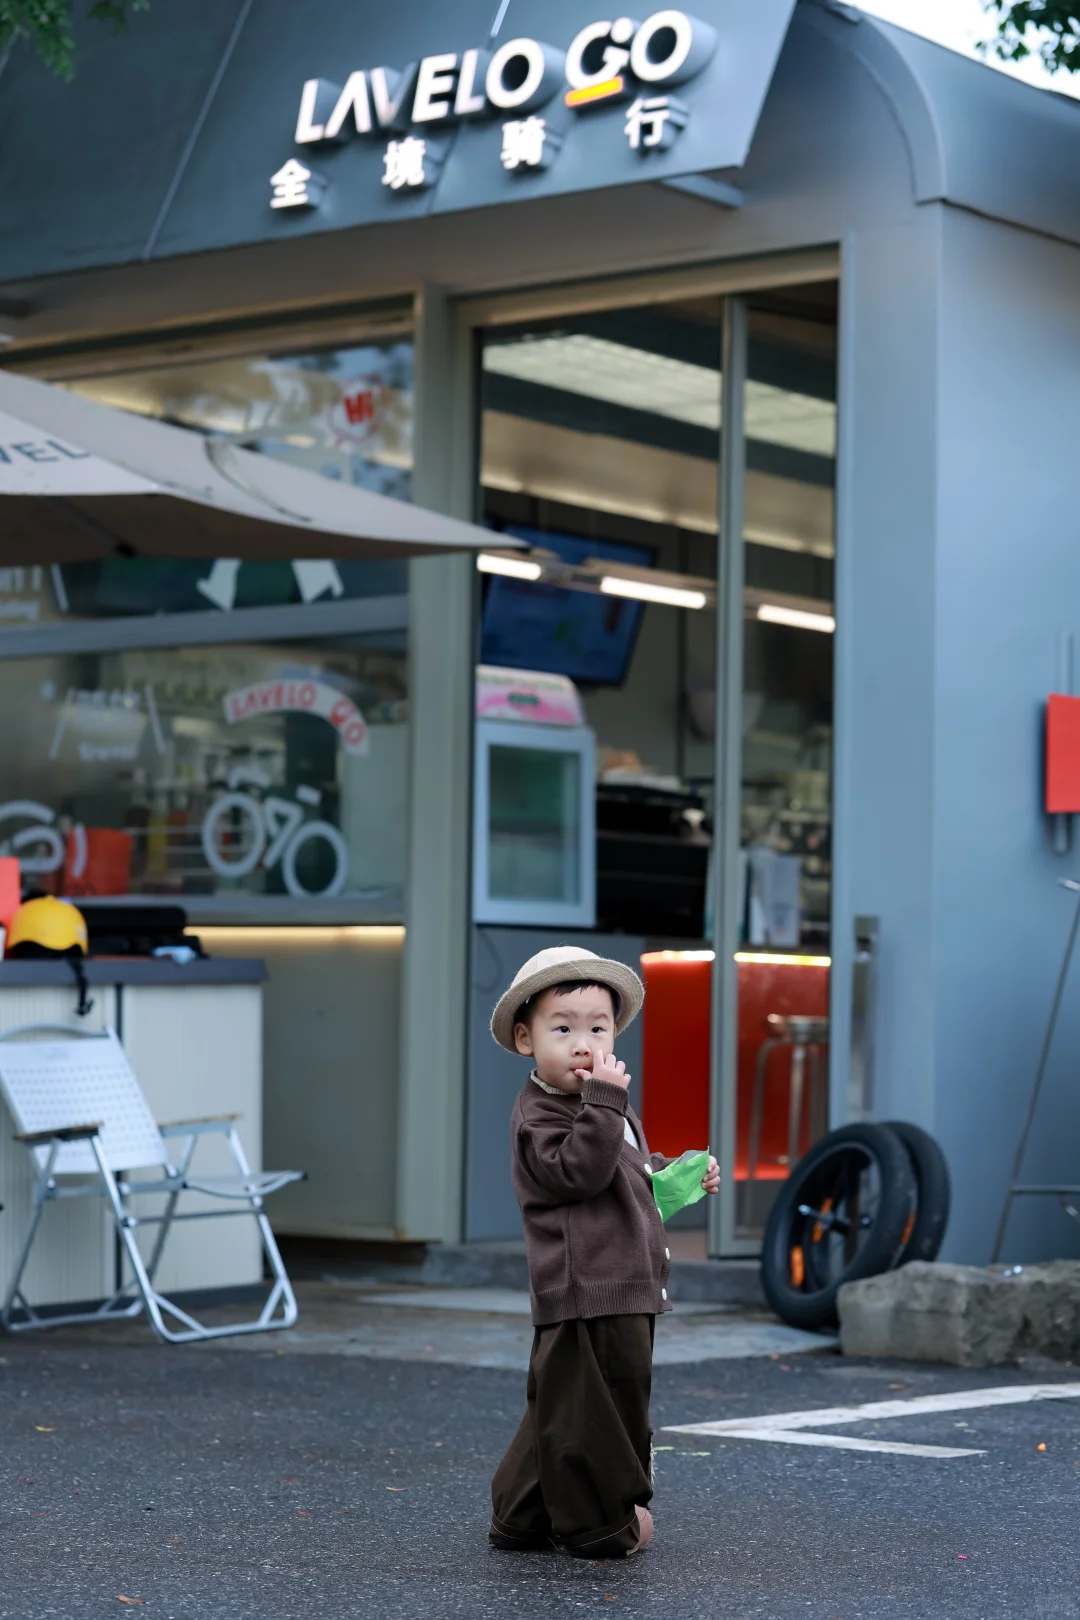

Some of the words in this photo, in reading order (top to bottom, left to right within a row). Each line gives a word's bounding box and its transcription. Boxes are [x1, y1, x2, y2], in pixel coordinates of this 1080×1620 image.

[295, 37, 545, 144] LAVELO
[565, 10, 693, 93] GO
[232, 683, 318, 719] LAVELO
[330, 697, 367, 746] GO
